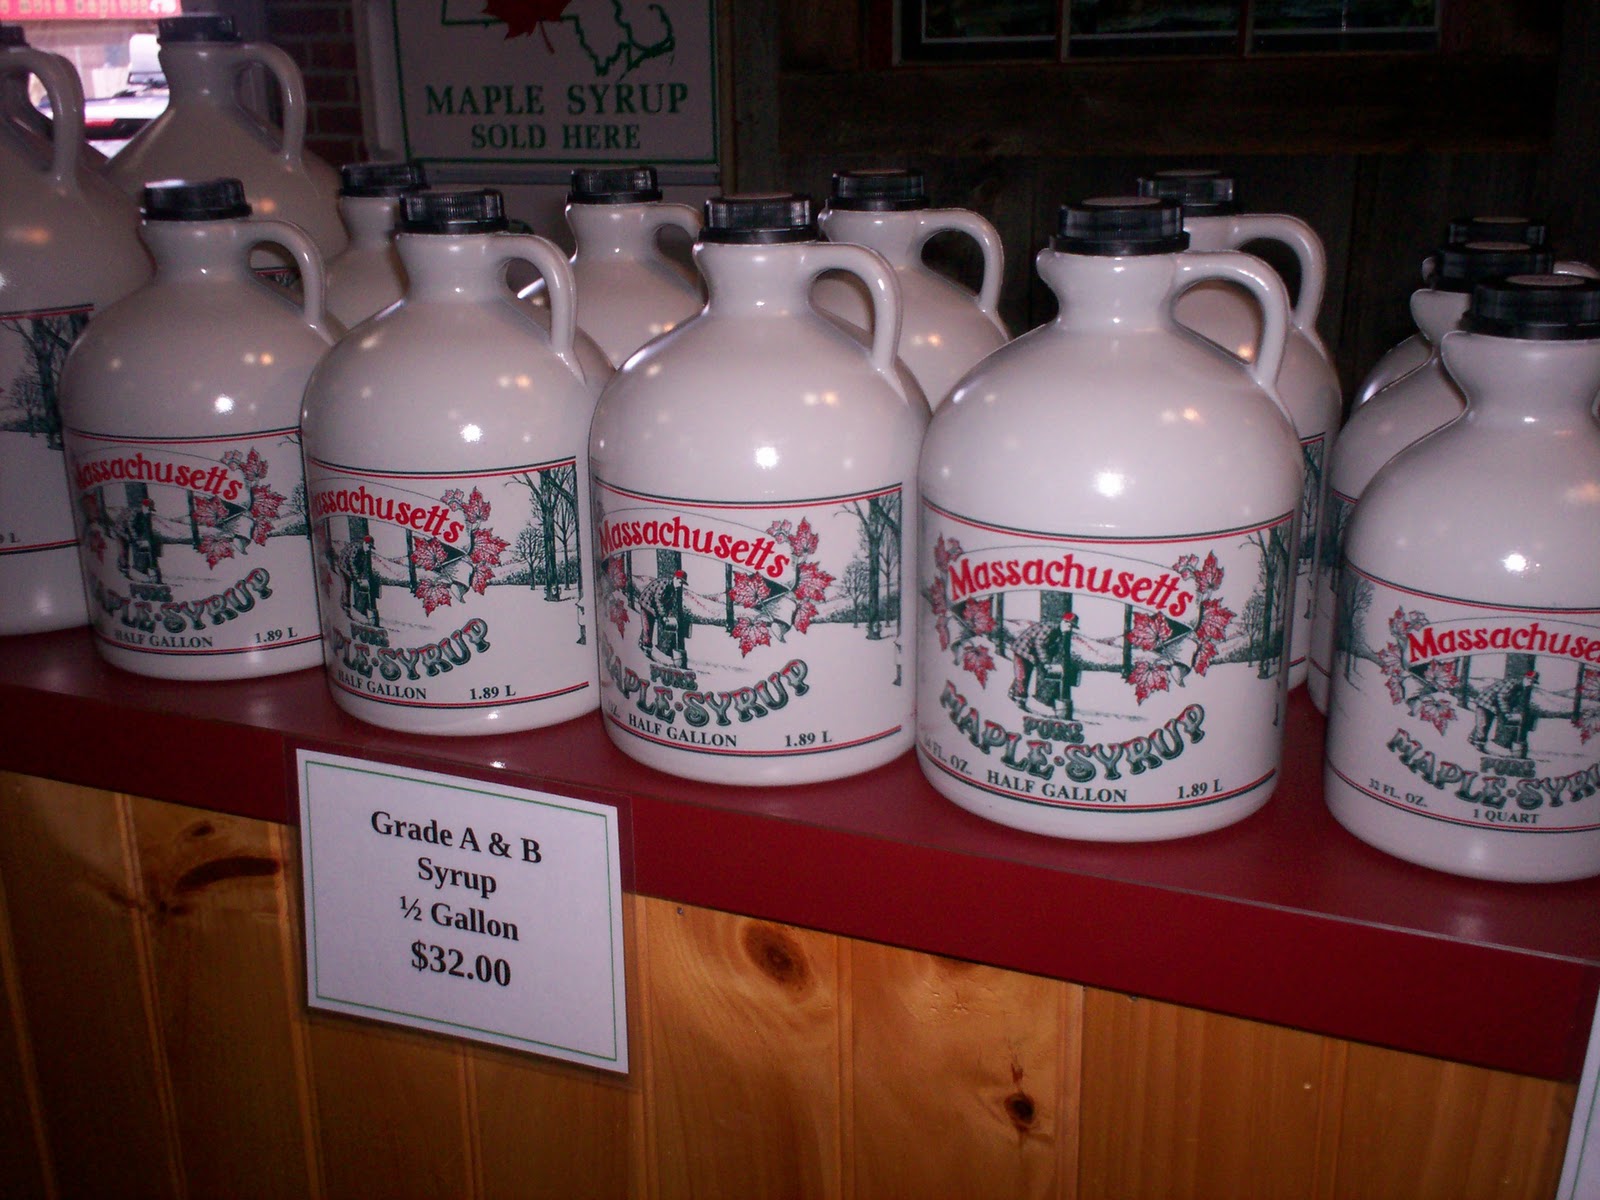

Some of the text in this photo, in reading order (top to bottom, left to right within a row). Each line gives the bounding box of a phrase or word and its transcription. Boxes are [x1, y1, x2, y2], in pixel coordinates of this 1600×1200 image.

[425, 82, 689, 116] MAPLE SYRUP
[471, 123, 641, 149] SOLD HERE
[600, 516, 790, 578] Massachusetts
[948, 554, 1194, 618] Massachusetts
[149, 635, 213, 648] GALLON
[255, 629, 283, 644] 1.89
[288, 627, 298, 639] L
[1407, 623, 1600, 664] Massachuse
[367, 681, 427, 699] GALLON
[470, 688, 499, 700] 1.89
[505, 685, 516, 697] L
[628, 713, 662, 735] HALF
[667, 726, 737, 747] GALLON
[784, 732, 816, 747] 1.89
[822, 730, 832, 743] L
[950, 754, 972, 775] OZ.
[987, 769, 1035, 793] HALF
[1041, 783, 1127, 803] GALLON
[1177, 783, 1209, 799] 1.89
[1213, 779, 1223, 792] L
[1383, 785, 1400, 799] FL.
[1405, 792, 1428, 808] OZ.
[1473, 809, 1480, 819] 1
[1485, 810, 1540, 824] QUART
[371, 810, 542, 864] Grade A & B
[418, 857, 497, 899] Syrup
[431, 902, 519, 941] Gallon
[411, 940, 511, 987] $32.00
